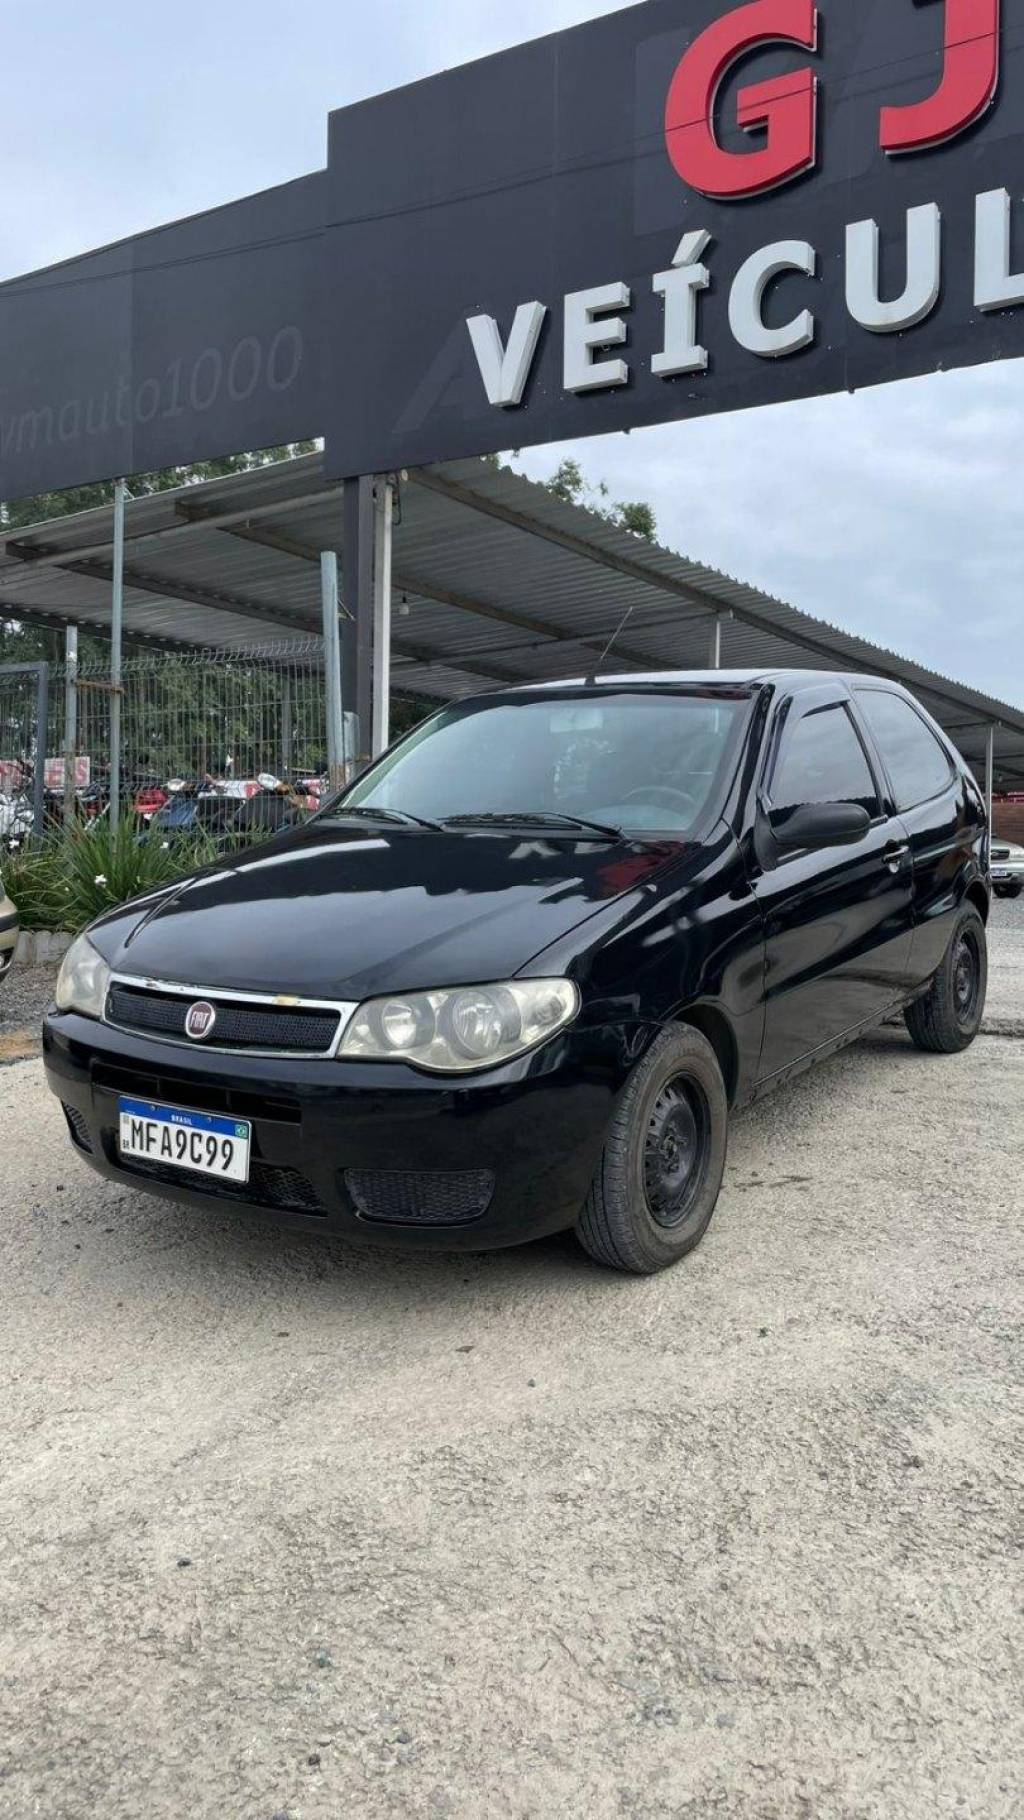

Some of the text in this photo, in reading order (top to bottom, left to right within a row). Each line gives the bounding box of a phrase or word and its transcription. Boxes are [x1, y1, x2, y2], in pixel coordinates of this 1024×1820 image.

[466, 187, 1024, 408] VEÍCUL
[131, 1118, 234, 1171] MFA9C99
[171, 1114, 192, 1126] BRASIL
